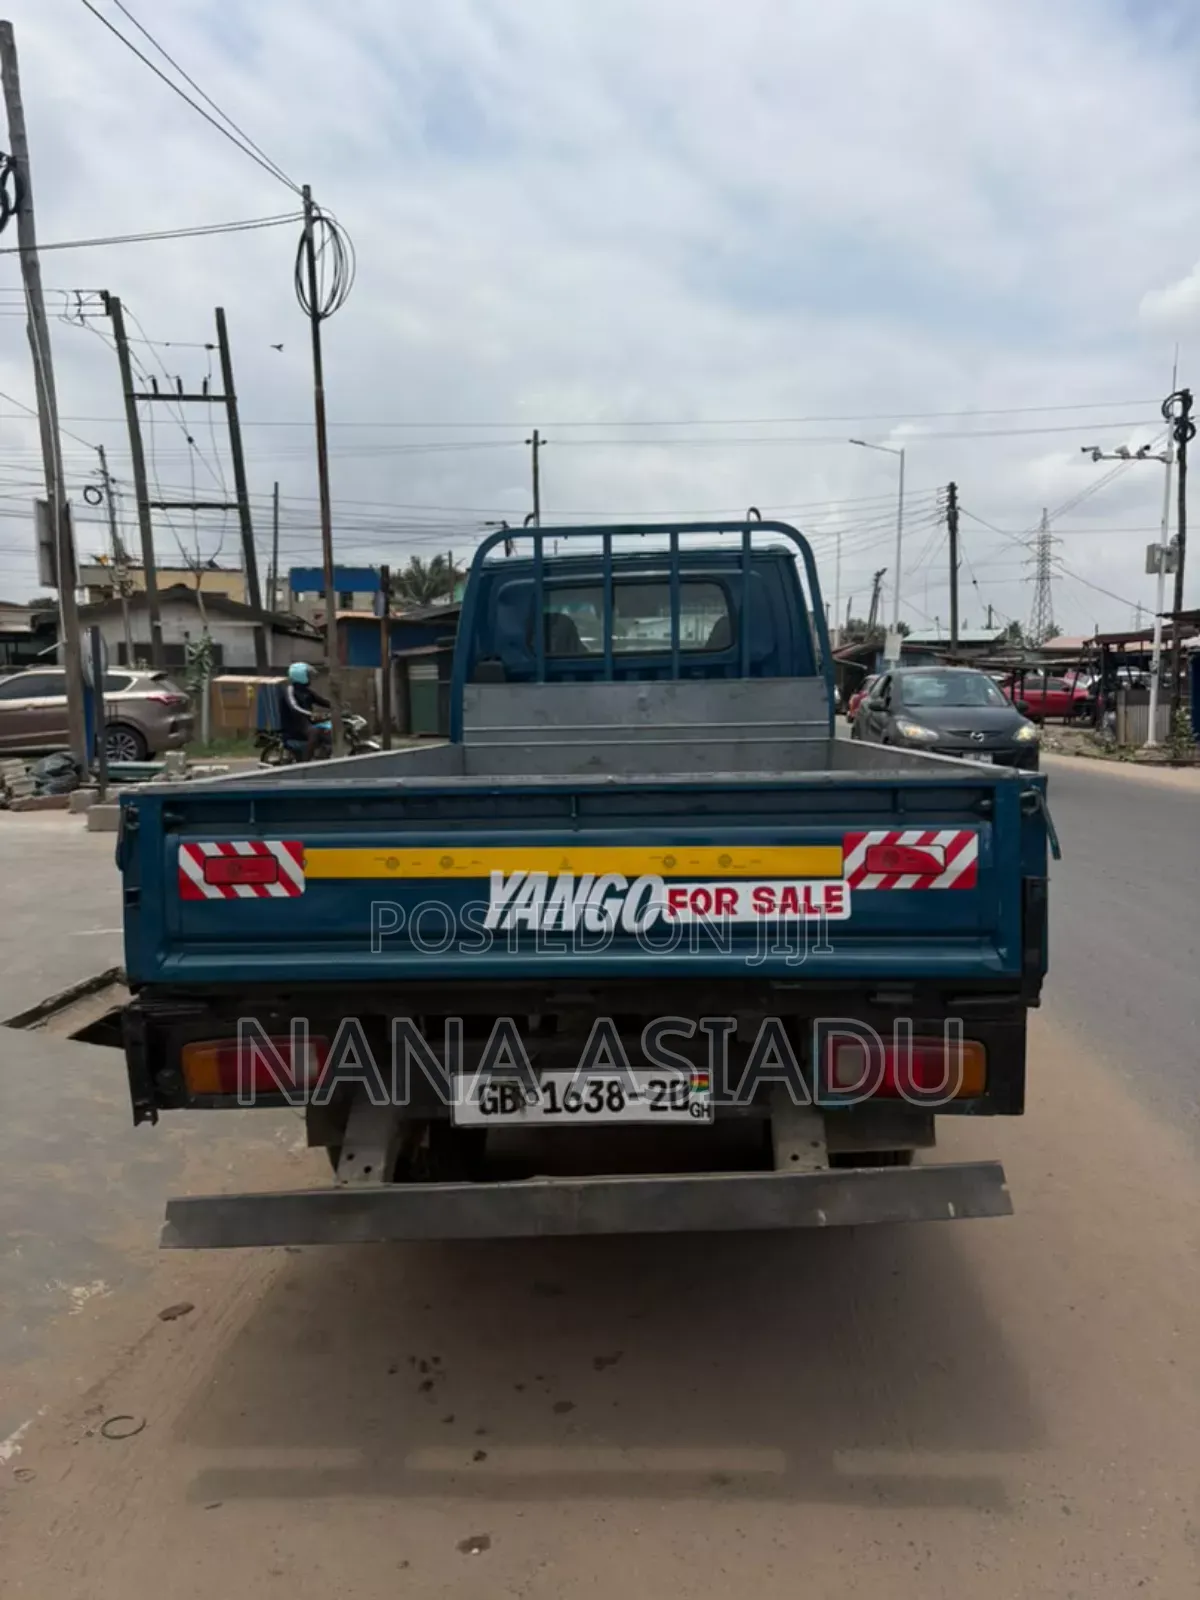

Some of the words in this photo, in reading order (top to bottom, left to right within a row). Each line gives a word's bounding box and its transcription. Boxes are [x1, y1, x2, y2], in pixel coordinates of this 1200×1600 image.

[483, 870, 664, 934] YANGO
[667, 887, 740, 917] FOR
[752, 885, 844, 915] SALE
